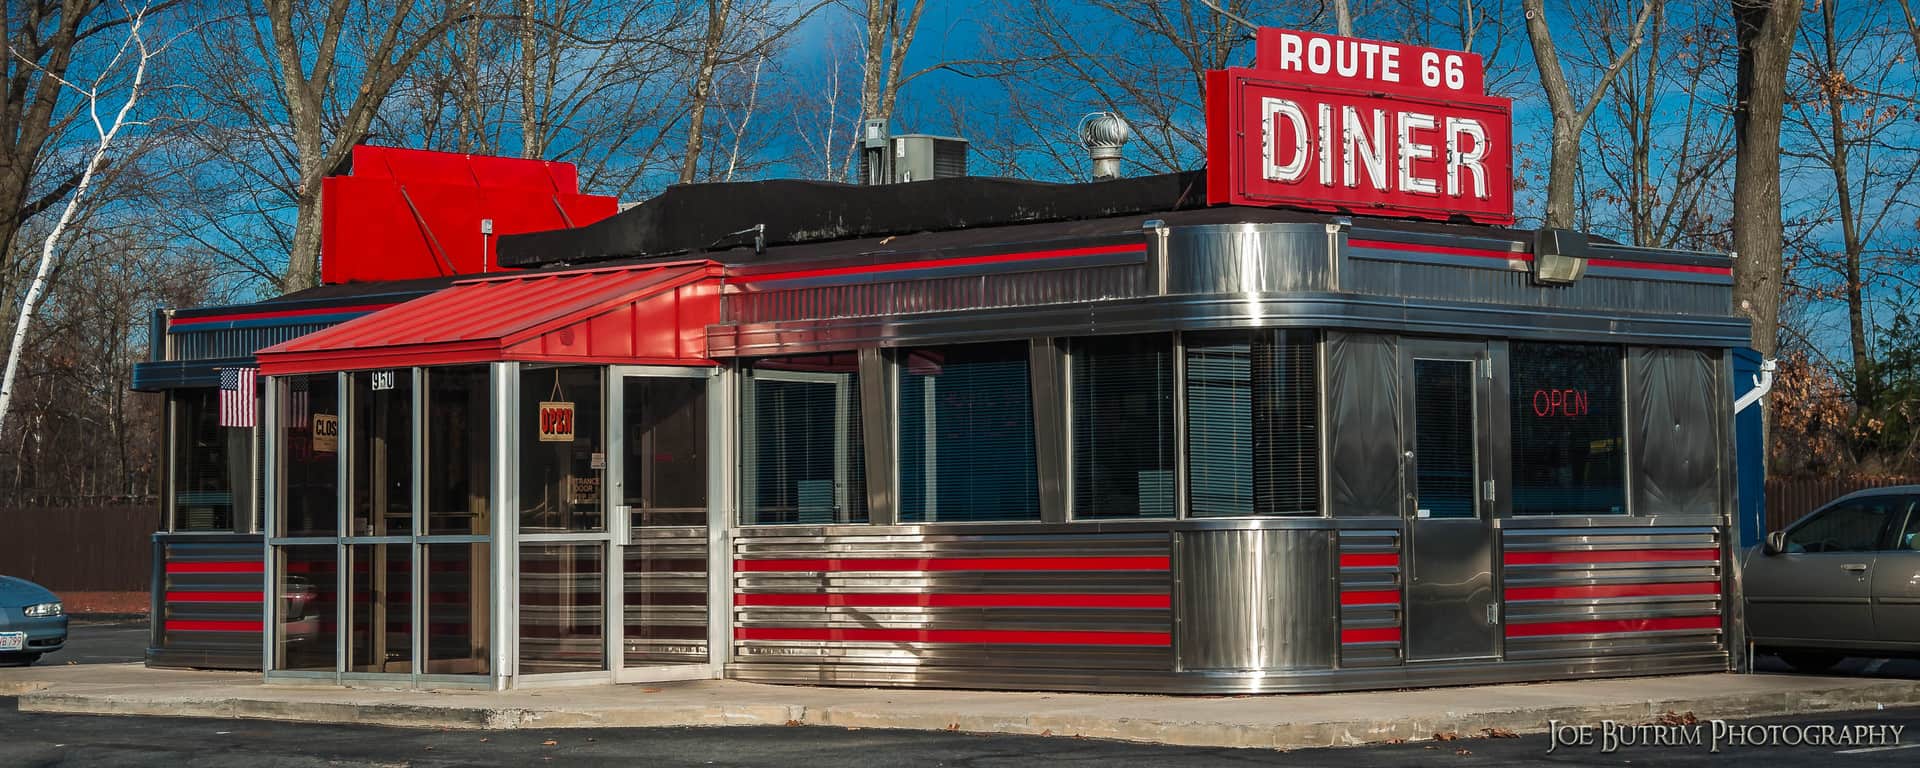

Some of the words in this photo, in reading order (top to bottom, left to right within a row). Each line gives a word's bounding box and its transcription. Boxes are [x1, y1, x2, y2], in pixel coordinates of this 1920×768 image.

[1280, 33, 1400, 82] ROUTE
[1421, 52, 1464, 90] 66
[1262, 96, 1490, 200] DINER
[373, 370, 392, 389] 950
[1533, 390, 1588, 416] OPEN
[541, 407, 573, 434] OPEN
